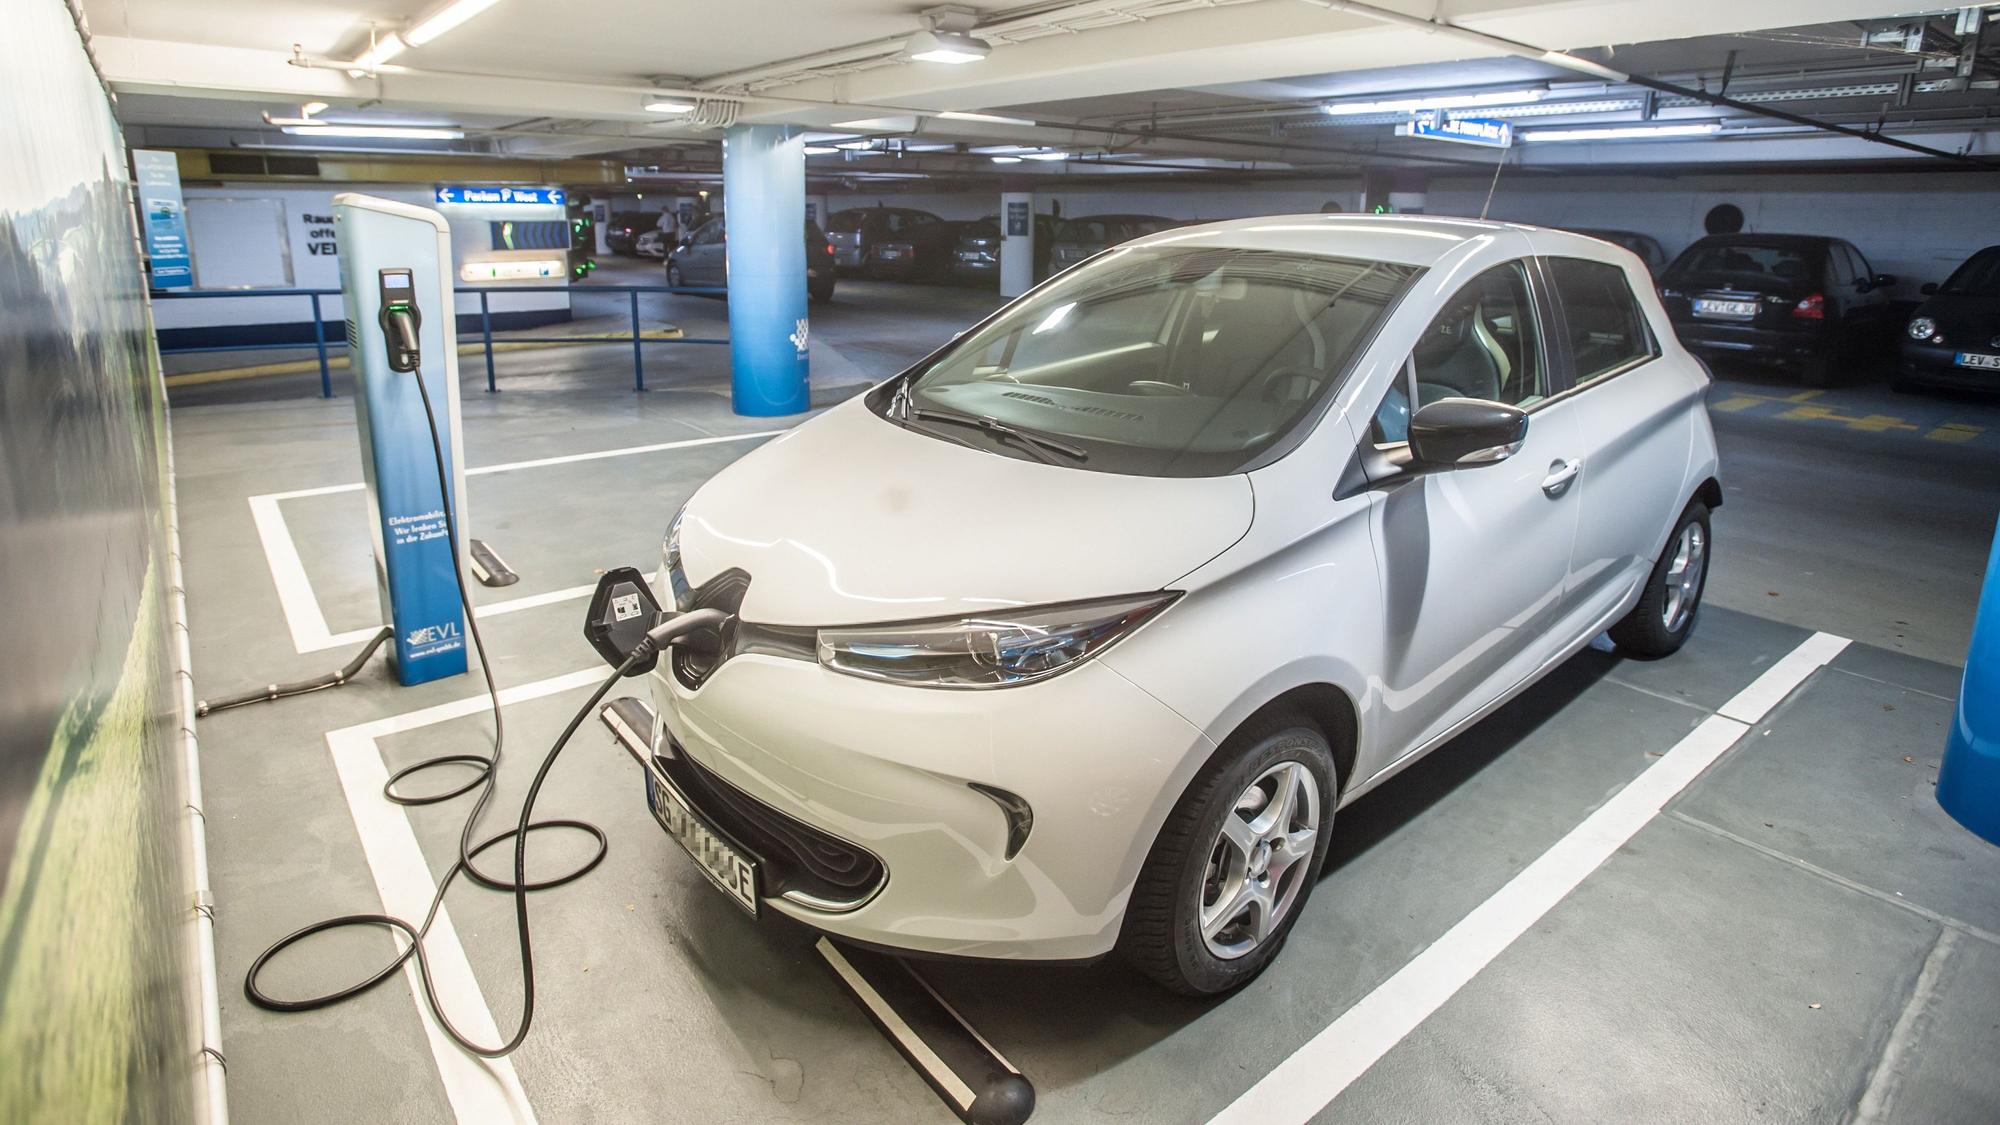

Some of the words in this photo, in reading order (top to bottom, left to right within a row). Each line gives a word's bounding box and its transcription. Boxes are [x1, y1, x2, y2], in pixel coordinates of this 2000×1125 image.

[463, 189, 500, 202] Parken
[513, 191, 538, 203] West
[1962, 354, 1985, 366] LEV
[427, 622, 461, 641] EVL
[655, 781, 672, 826] SG
